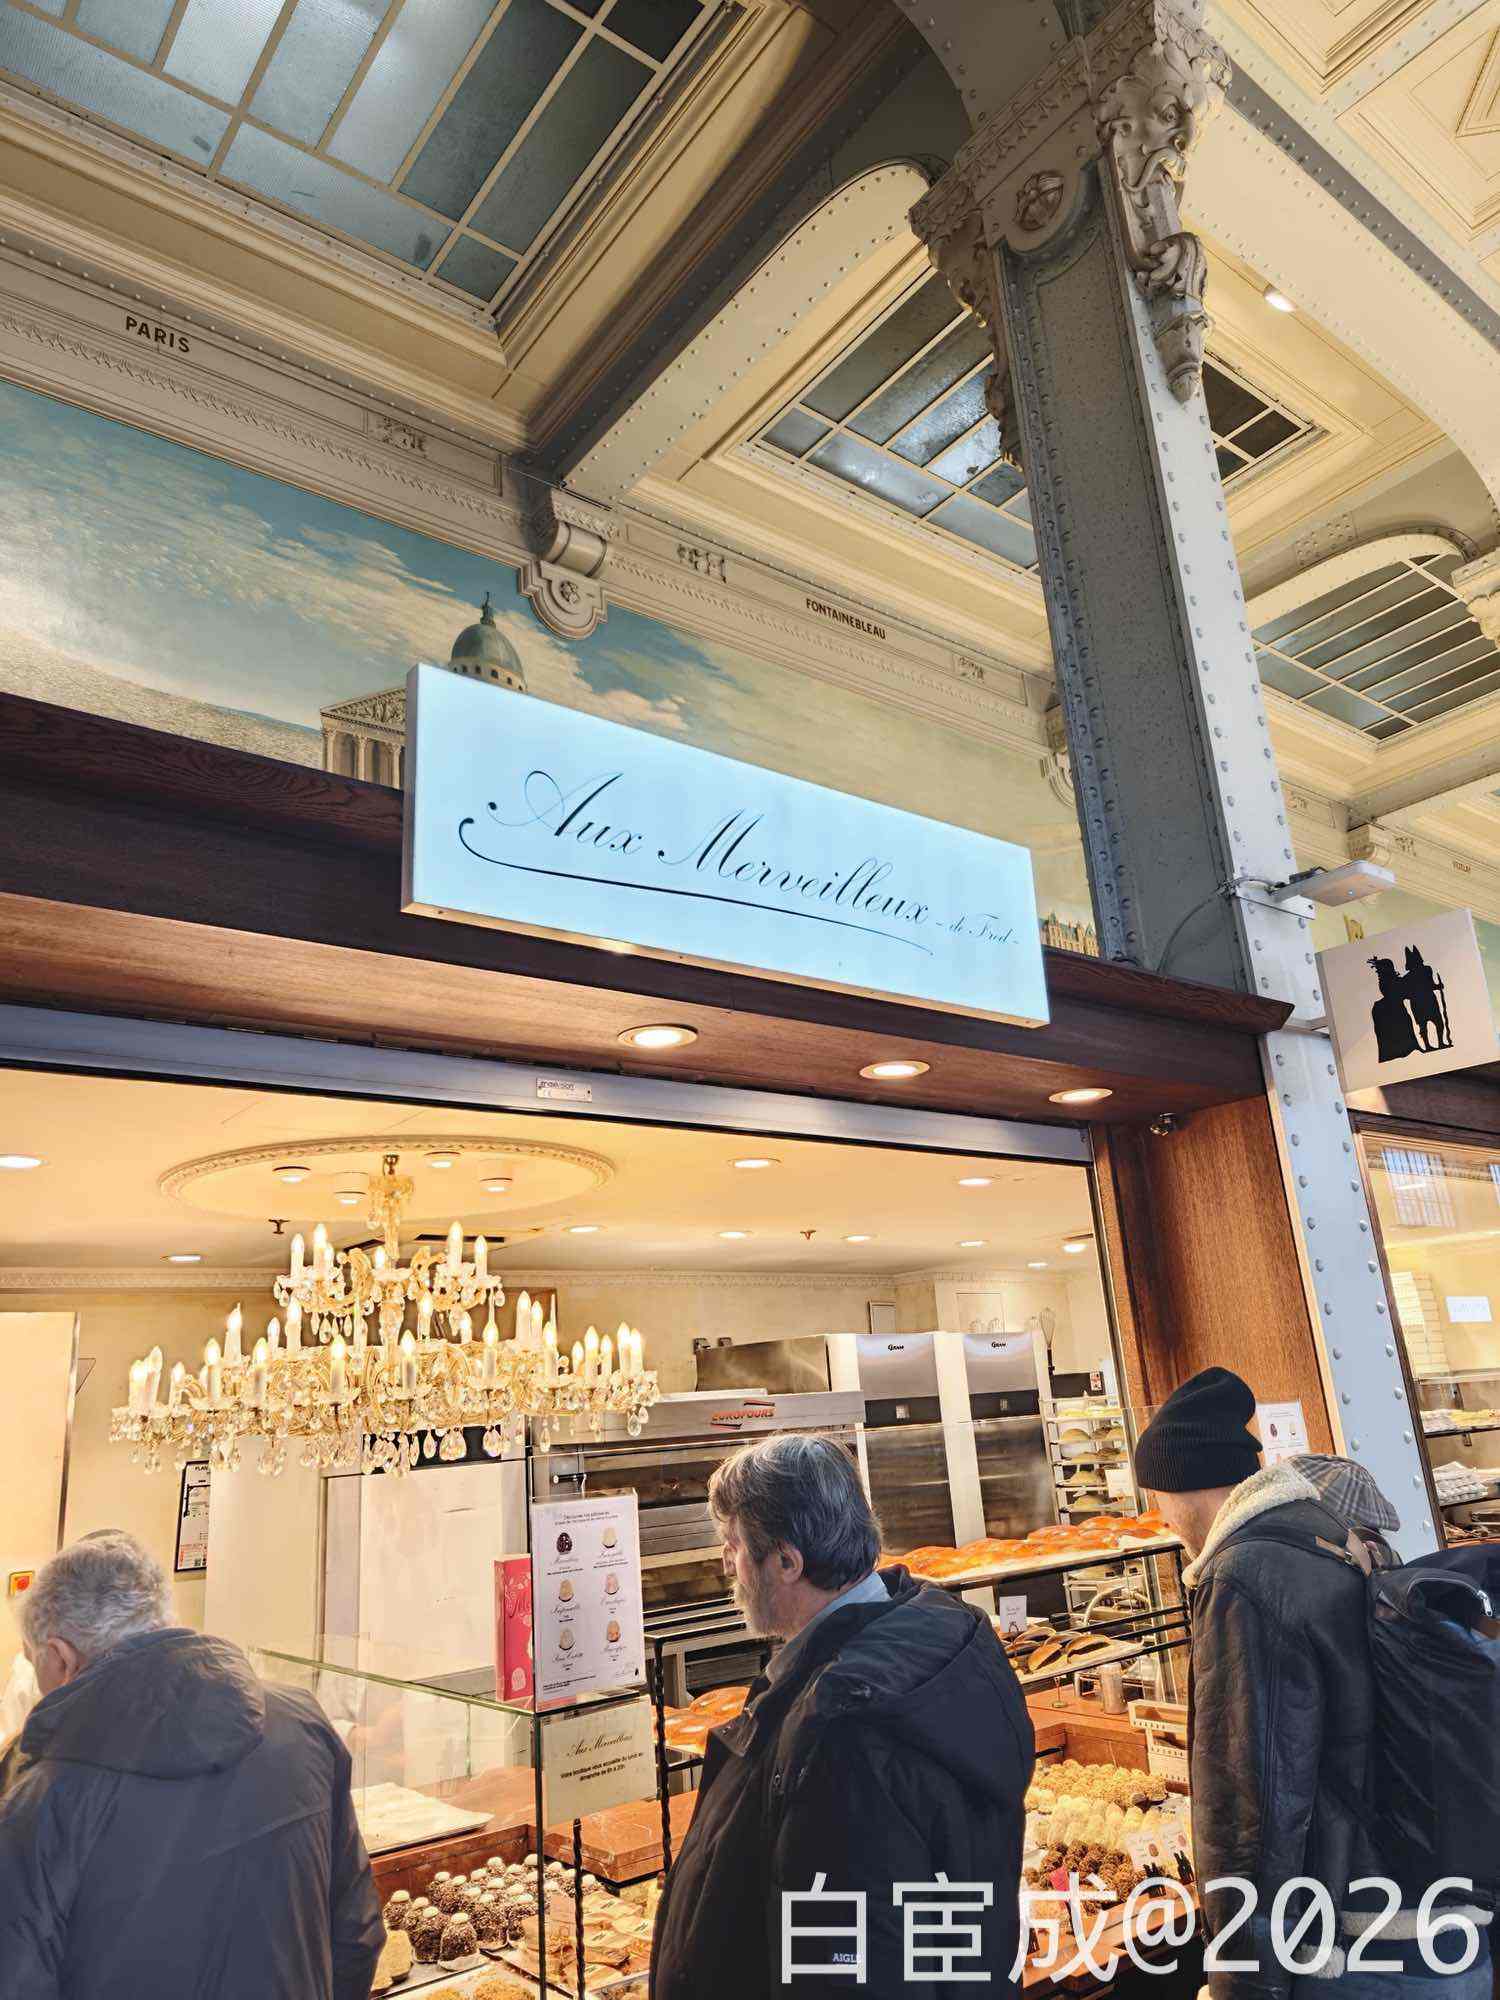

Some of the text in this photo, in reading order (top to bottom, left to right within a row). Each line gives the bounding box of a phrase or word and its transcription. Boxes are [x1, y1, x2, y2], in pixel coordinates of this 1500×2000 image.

[125, 316, 190, 353] PARIS
[805, 598, 886, 640] FONTAINEBLEAU
[487, 770, 642, 855] Aux
[658, 808, 928, 925] Merveilleux
